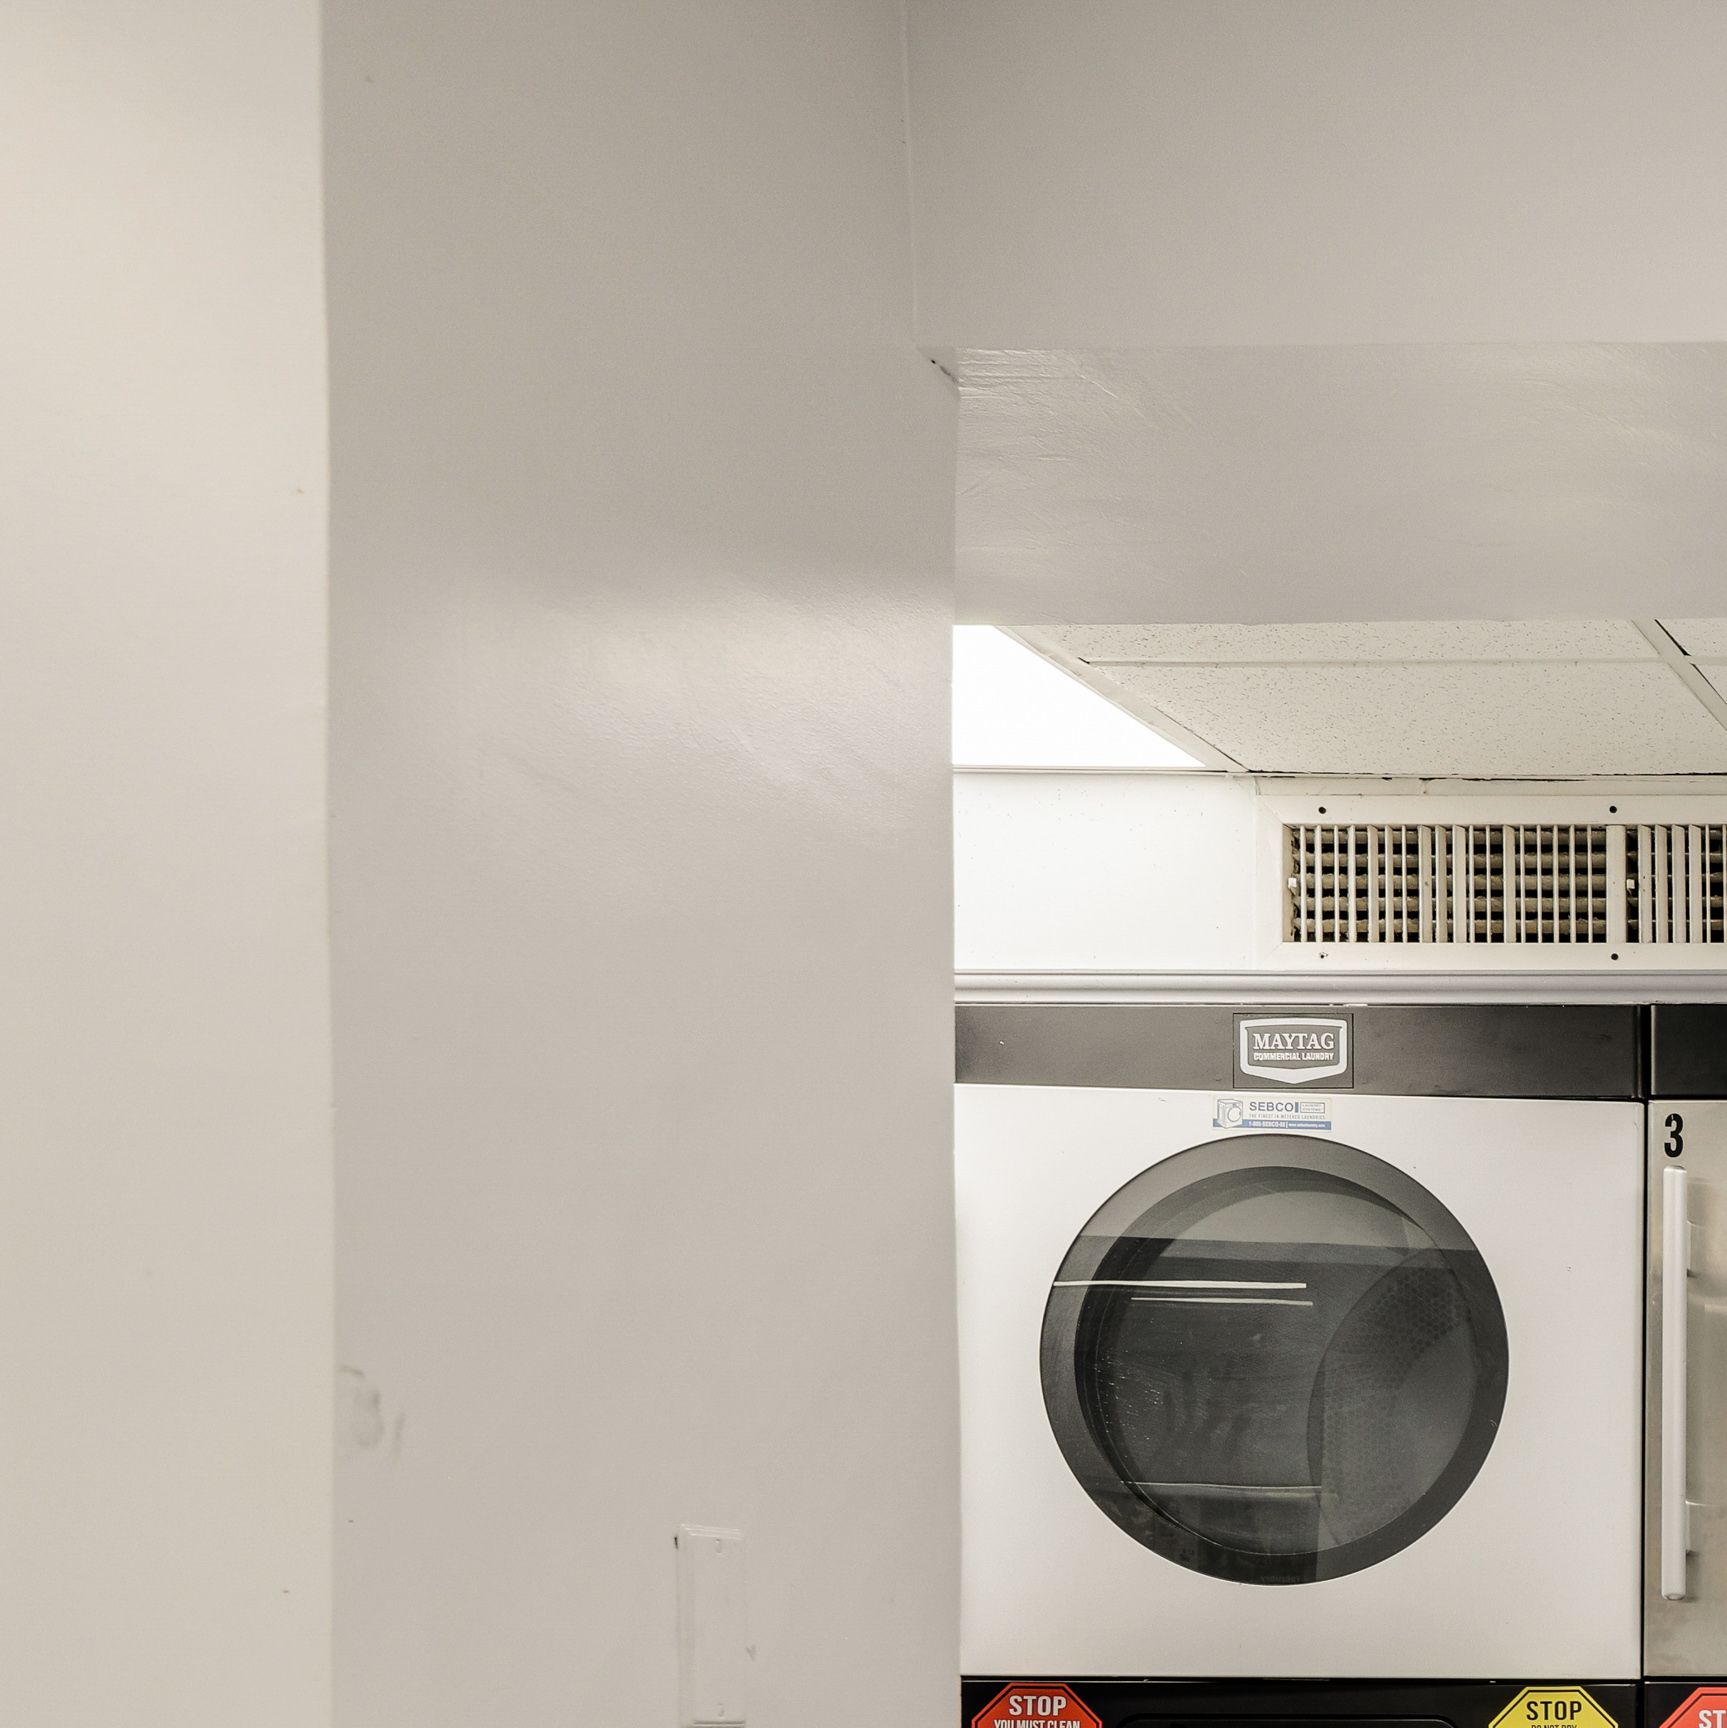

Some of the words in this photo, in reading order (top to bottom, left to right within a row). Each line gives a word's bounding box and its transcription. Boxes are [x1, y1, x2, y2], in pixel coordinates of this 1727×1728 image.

[1252, 1032, 1335, 1050] MAYTAG
[1253, 1052, 1301, 1062] COMMERCIAL
[1302, 1052, 1335, 1062] LAUNDRY
[1249, 1101, 1295, 1113] SEBCO
[1663, 1113, 1684, 1159] 3
[1008, 1695, 1067, 1717] STOP
[1526, 1700, 1583, 1721] STOP
